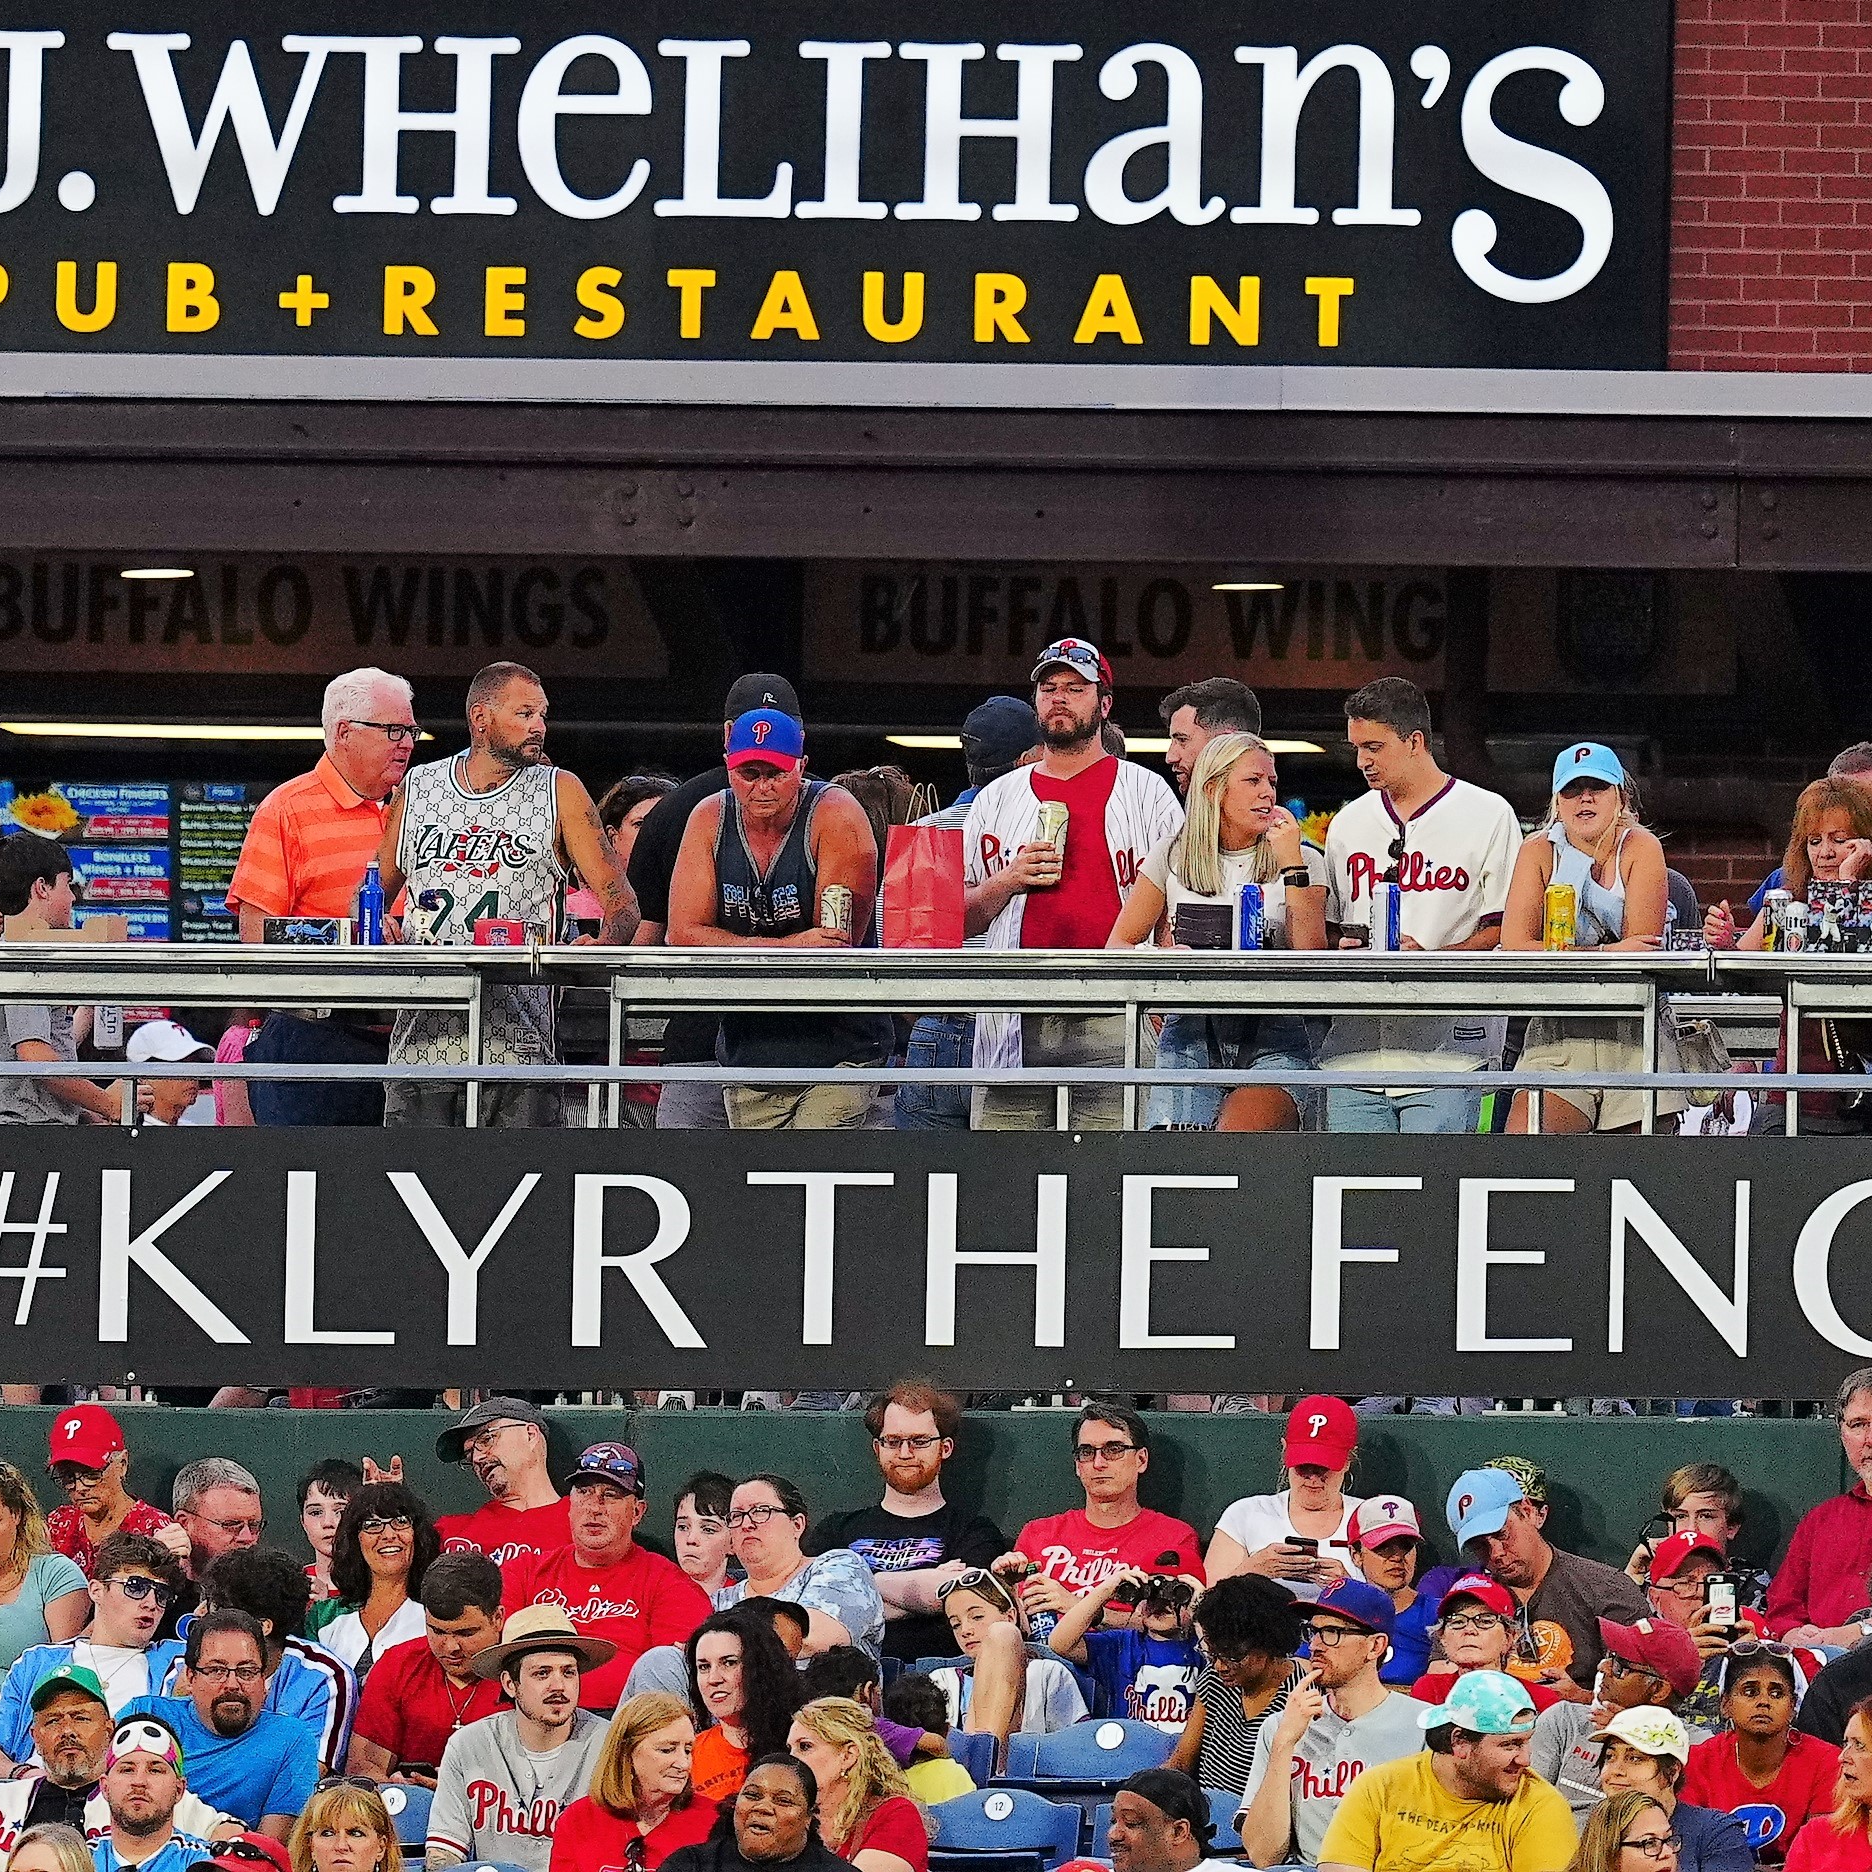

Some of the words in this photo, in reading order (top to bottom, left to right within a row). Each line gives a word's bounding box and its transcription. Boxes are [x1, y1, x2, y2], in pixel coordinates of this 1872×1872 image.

[383, 265, 1356, 350] RESTAURANT
[341, 565, 612, 651] WINGS
[860, 571, 1193, 658] BUFFALO
[752, 721, 772, 745] P
[1574, 747, 1591, 764] P
[1347, 851, 1469, 903] Phllies
[64, 1418, 82, 1440] P
[1307, 1413, 1329, 1438] P
[1381, 1501, 1399, 1519] P
[1457, 1494, 1474, 1520] P
[1678, 1530, 1697, 1545] P
